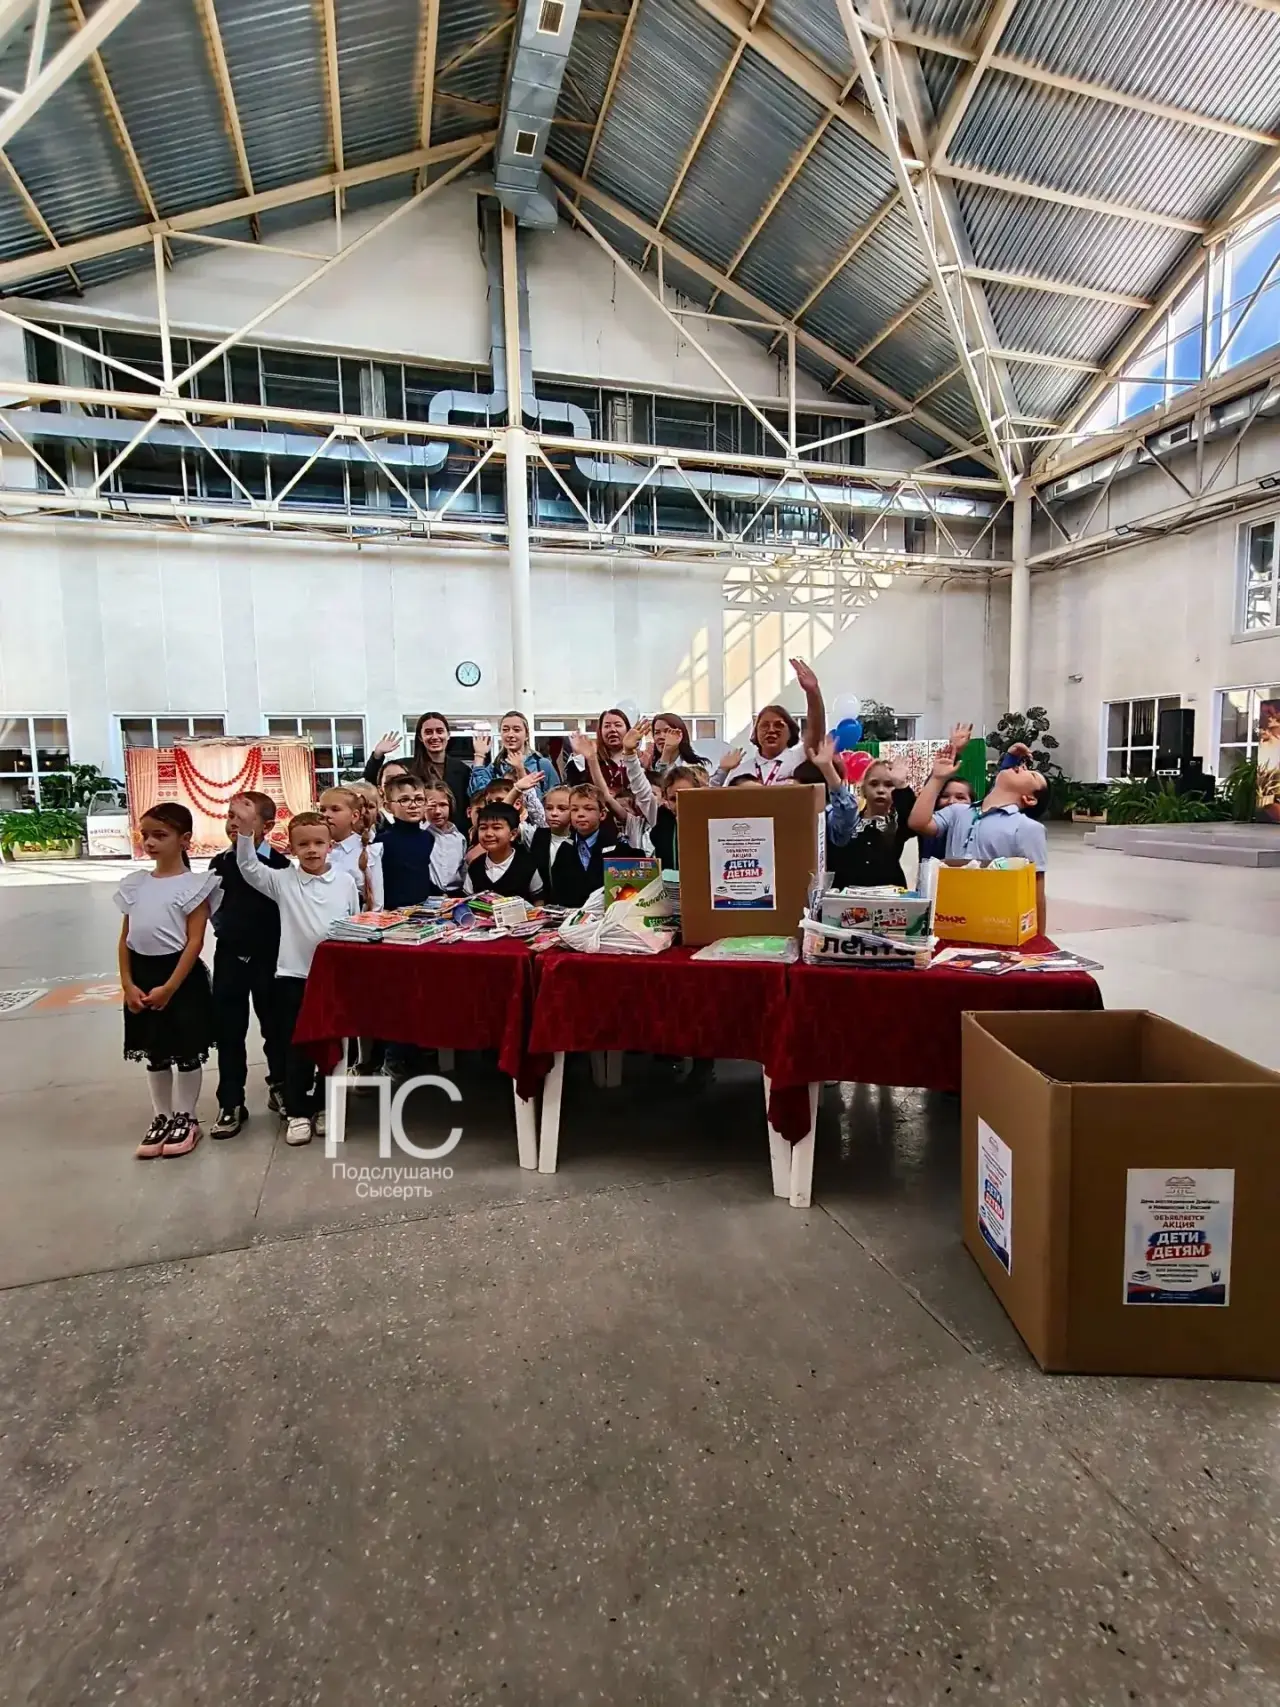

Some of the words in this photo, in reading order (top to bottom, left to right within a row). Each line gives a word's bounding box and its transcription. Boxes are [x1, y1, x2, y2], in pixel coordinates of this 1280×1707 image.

[729, 860, 755, 869] ДЕТИ
[726, 868, 760, 879] ДЕТЯМ
[1162, 1221, 1195, 1229] АКЦИЯ
[1157, 1231, 1199, 1246] ДЕТИ
[1152, 1244, 1205, 1260] ДЕТЯМ
